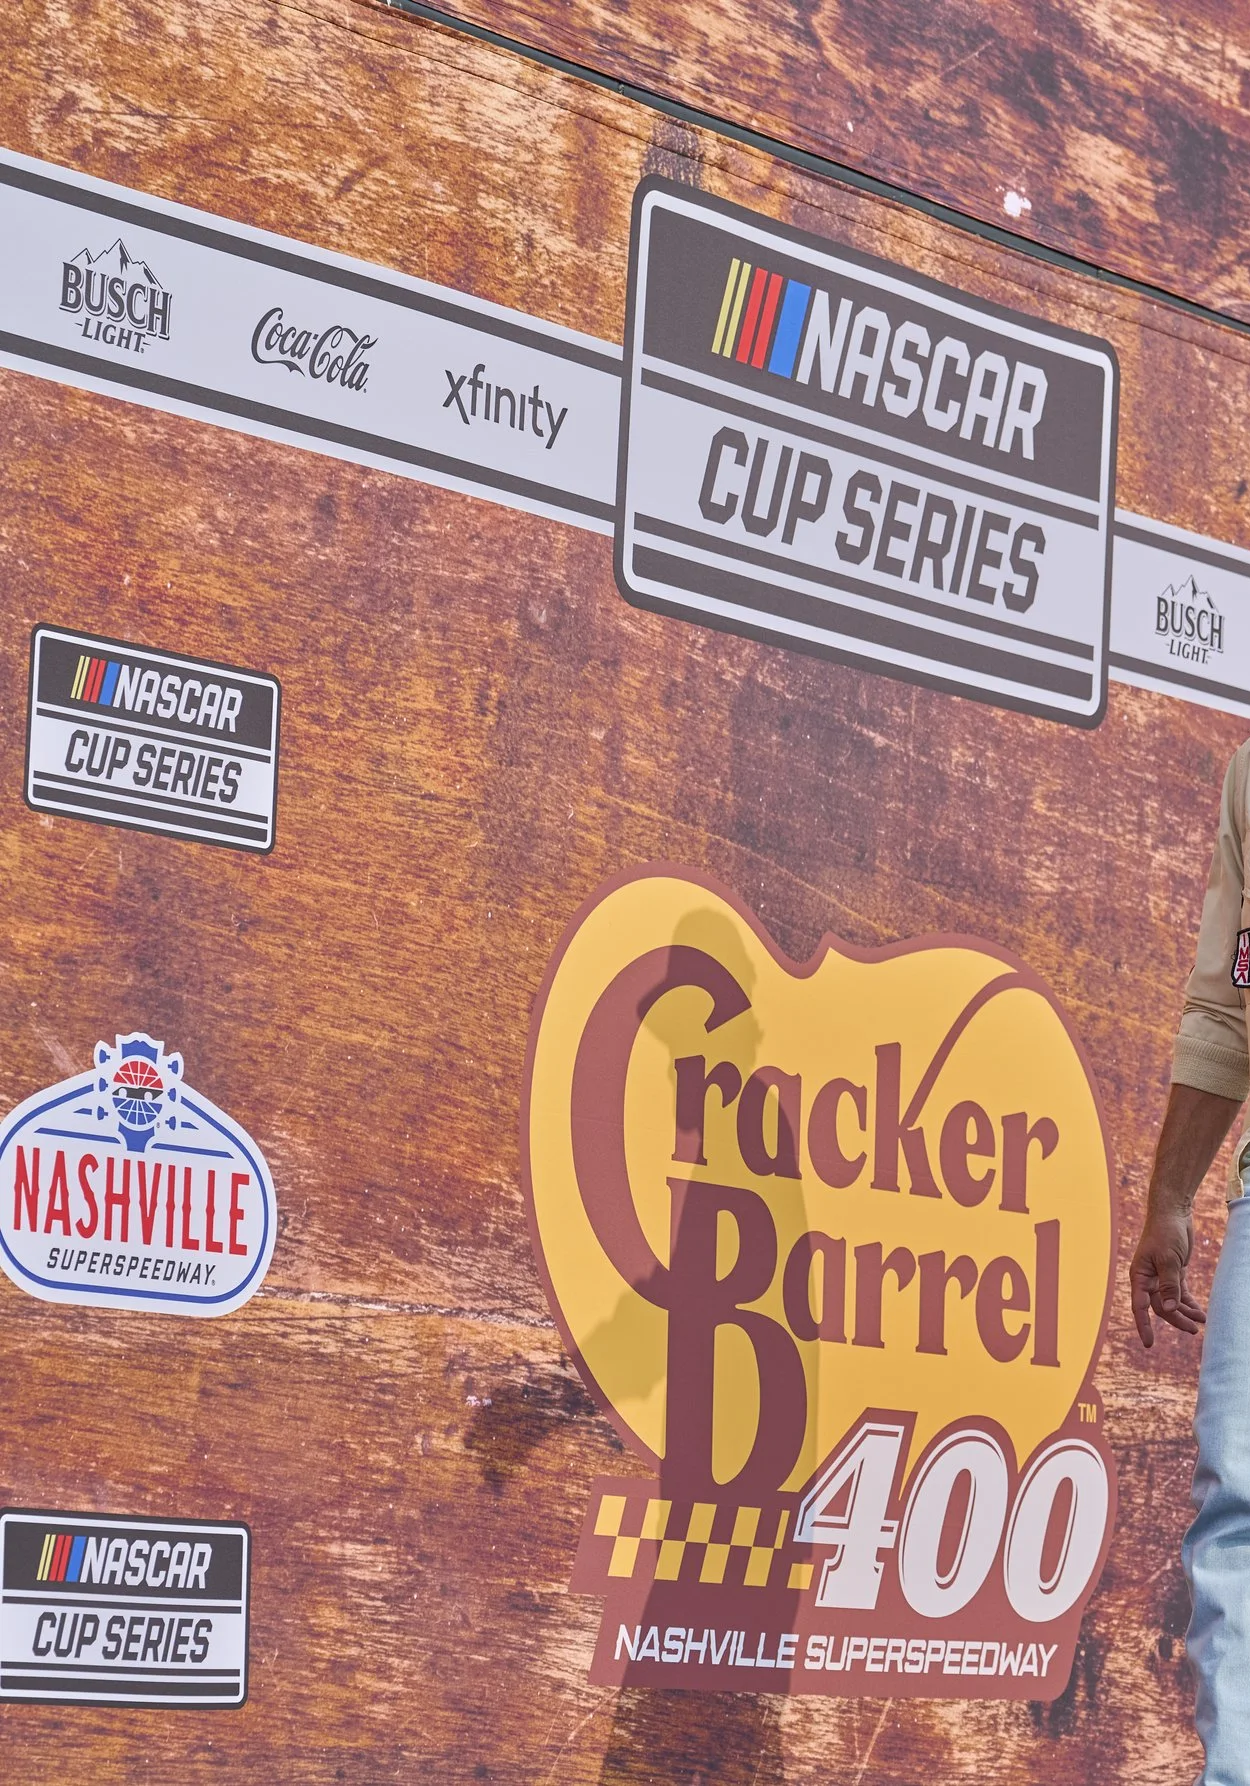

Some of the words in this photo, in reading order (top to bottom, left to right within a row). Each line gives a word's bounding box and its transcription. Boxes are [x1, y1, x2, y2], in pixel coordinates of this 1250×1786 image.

[60, 261, 172, 341] BUSCH
[81, 319, 146, 354] LIGHT
[251, 307, 379, 394] Coca-Cola
[796, 288, 1049, 461] NASCAR
[443, 363, 569, 449] xfinity
[698, 426, 833, 545] CUP
[834, 469, 1047, 614] SERIES
[1155, 595, 1225, 654] BUSCH
[1169, 638, 1209, 665] LIGHT
[112, 664, 243, 733] NASCAR
[64, 729, 132, 780] CUP
[132, 743, 243, 804] SERIES
[570, 944, 1060, 1310] Cracker
[13, 1144, 250, 1257] NASHVILLE
[46, 1247, 216, 1286] SUPERSPEEDWAY
[666, 1175, 1061, 1492] Barrel
[793, 1422, 1109, 1623] 400
[79, 1536, 213, 1590] NASCAR
[32, 1611, 101, 1659] CUP
[101, 1615, 213, 1664] SERIES
[613, 1623, 799, 1670] NASHVILLE
[804, 1634, 1058, 1678] SUPERSPEEDWAY
